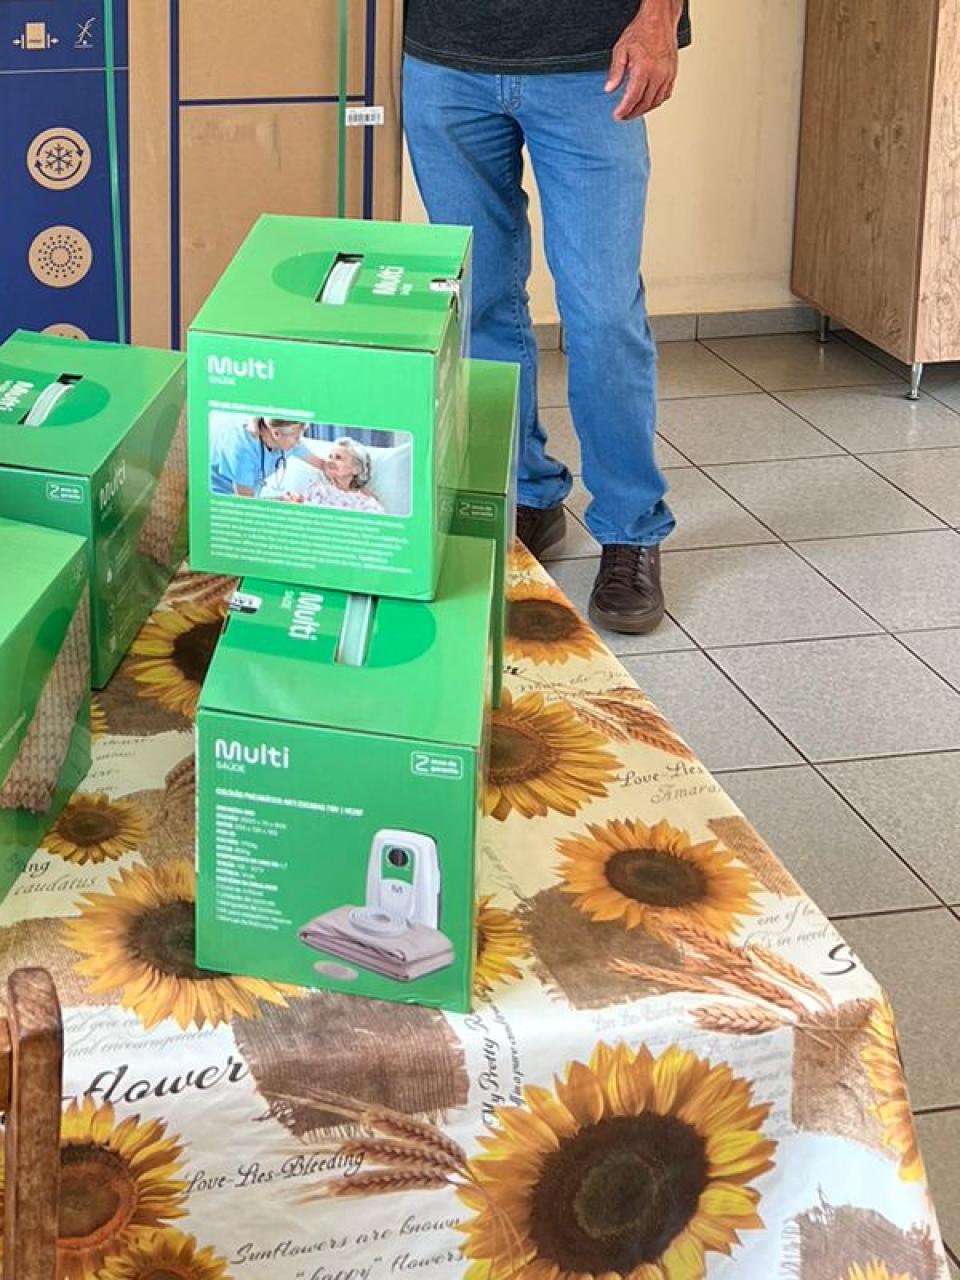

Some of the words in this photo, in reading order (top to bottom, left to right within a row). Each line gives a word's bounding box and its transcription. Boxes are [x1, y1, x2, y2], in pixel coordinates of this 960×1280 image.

[207, 354, 275, 381] Multi
[99, 460, 129, 510] Multi
[288, 591, 325, 641] Multi
[215, 738, 290, 769] Multi
[414, 754, 431, 773] 2
[230, 1239, 348, 1266] Sunflowers
[355, 1228, 394, 1245] are
